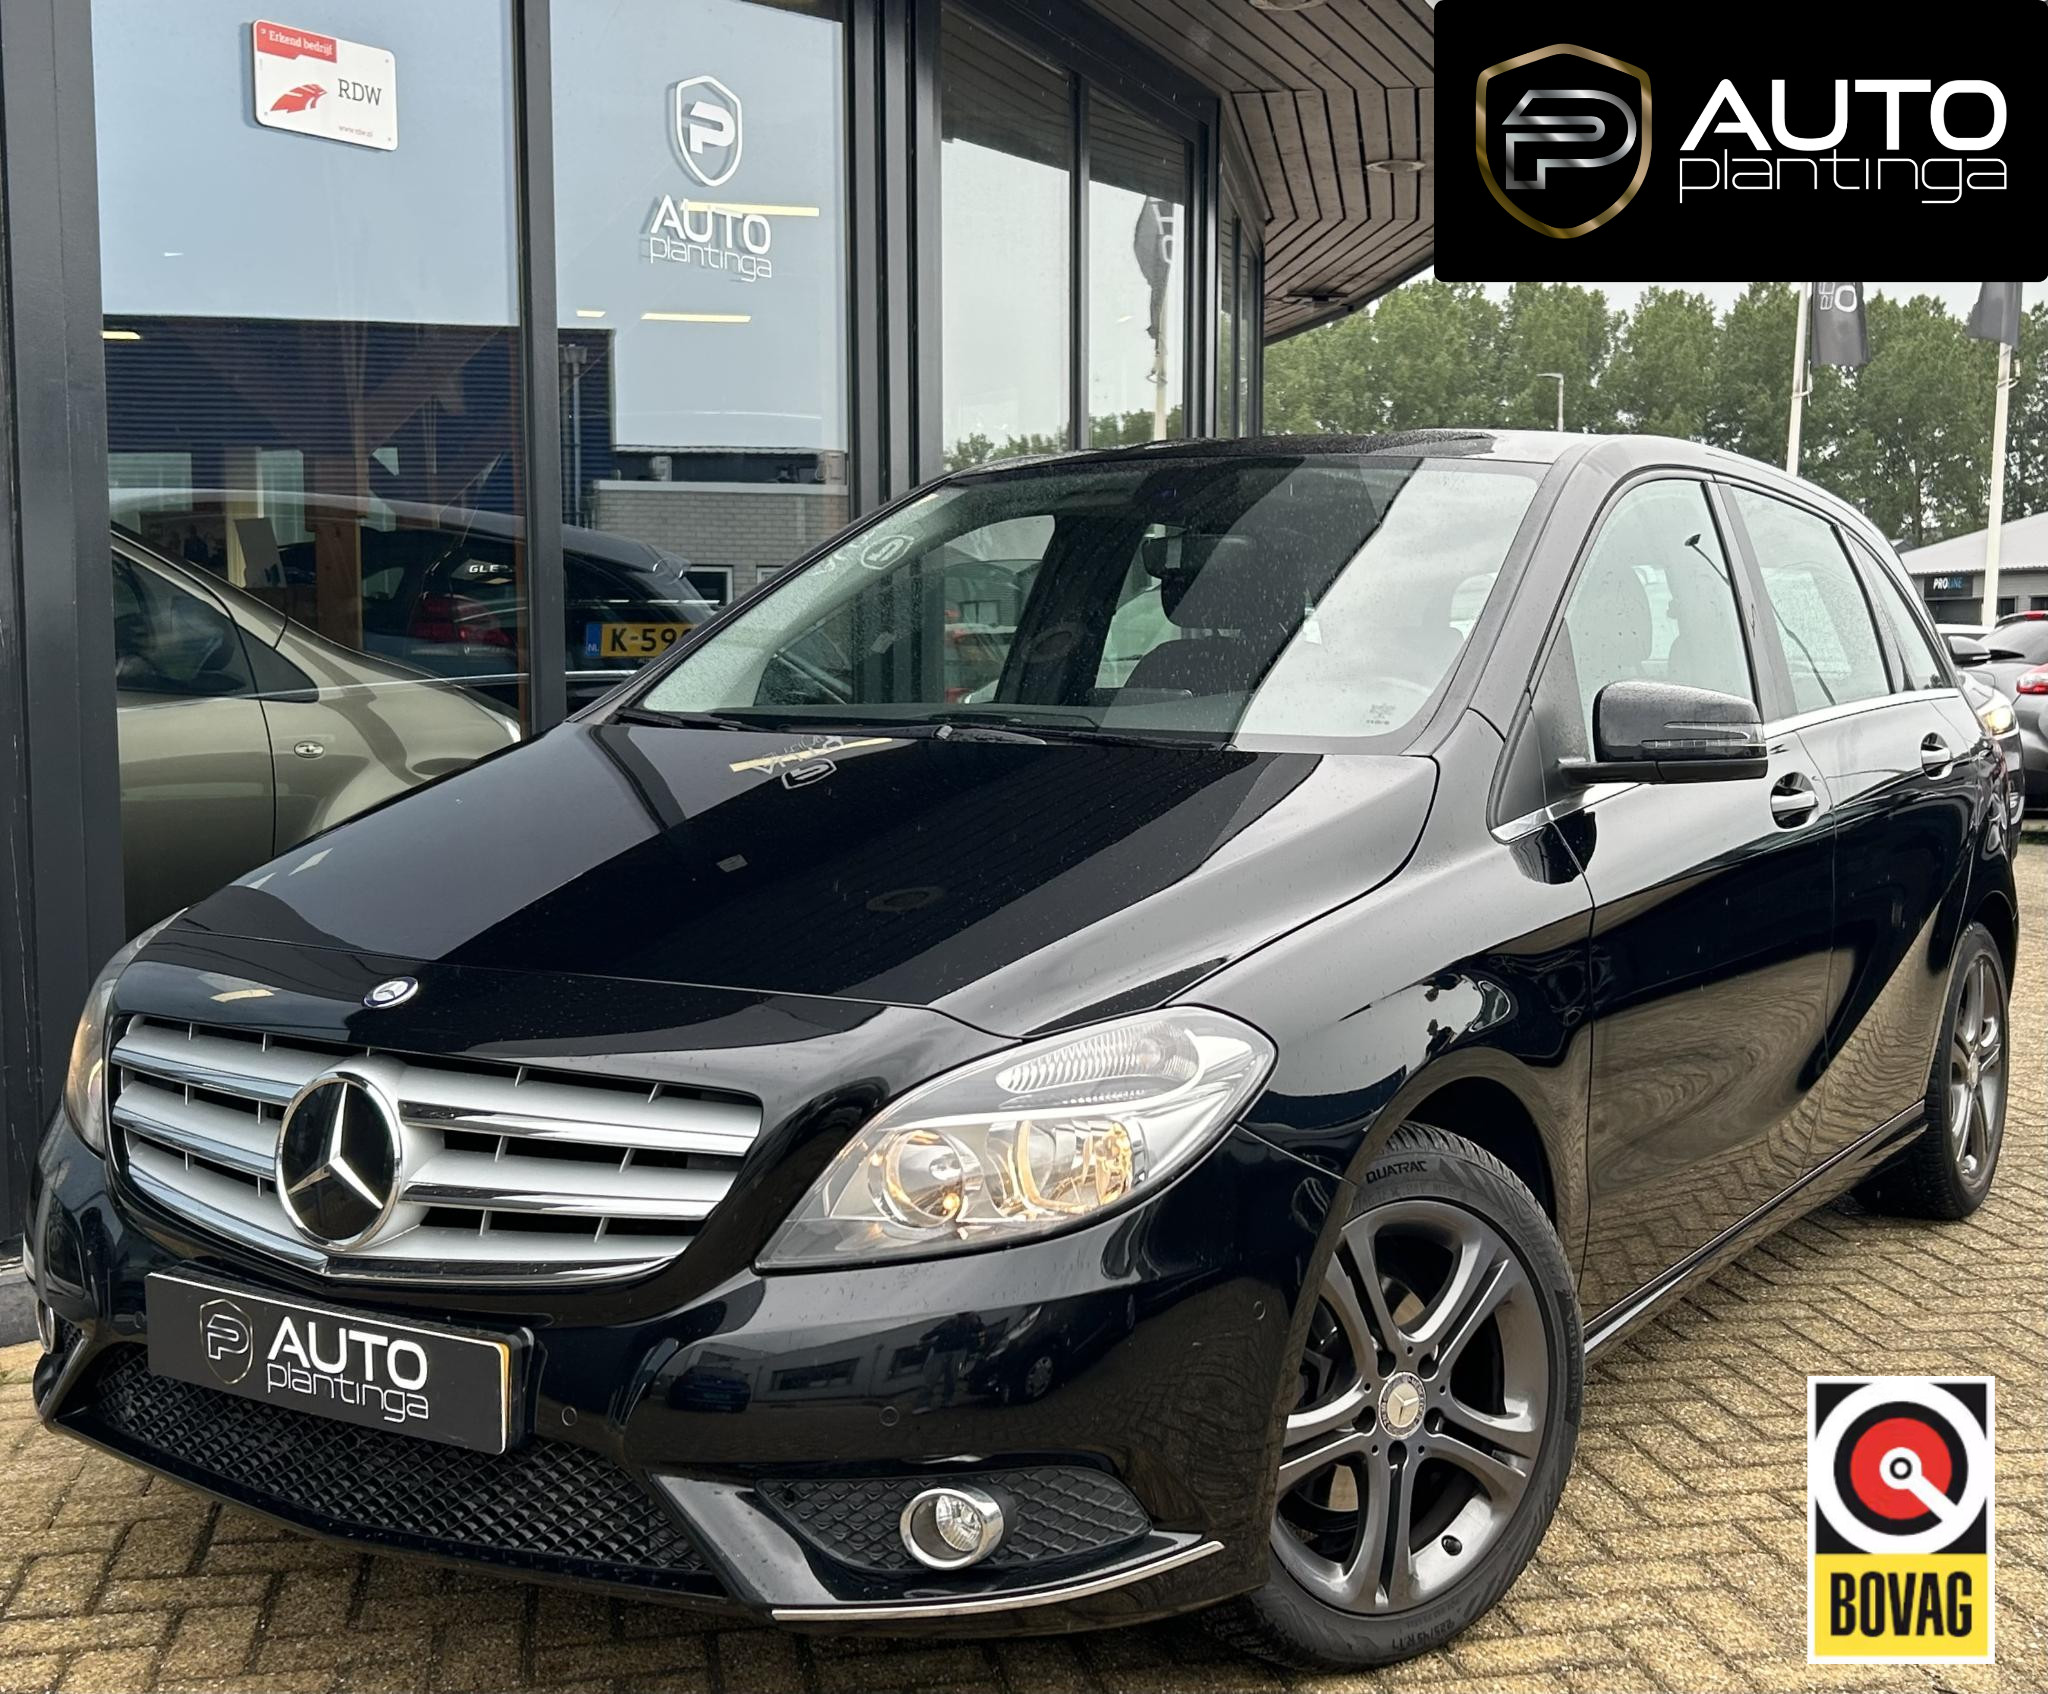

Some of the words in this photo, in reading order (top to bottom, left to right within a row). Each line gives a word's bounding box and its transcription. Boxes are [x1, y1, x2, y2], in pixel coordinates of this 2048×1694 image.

[268, 30, 302, 48] Erkend
[303, 38, 333, 56] bedrijf
[337, 78, 383, 106] RDW
[650, 194, 772, 255] AUTO
[650, 235, 773, 283] plantinga
[610, 628, 691, 652] K-59
[1365, 1160, 1428, 1184] QUATRAC
[267, 1316, 428, 1391] AUTO
[266, 1361, 430, 1423] plantinga
